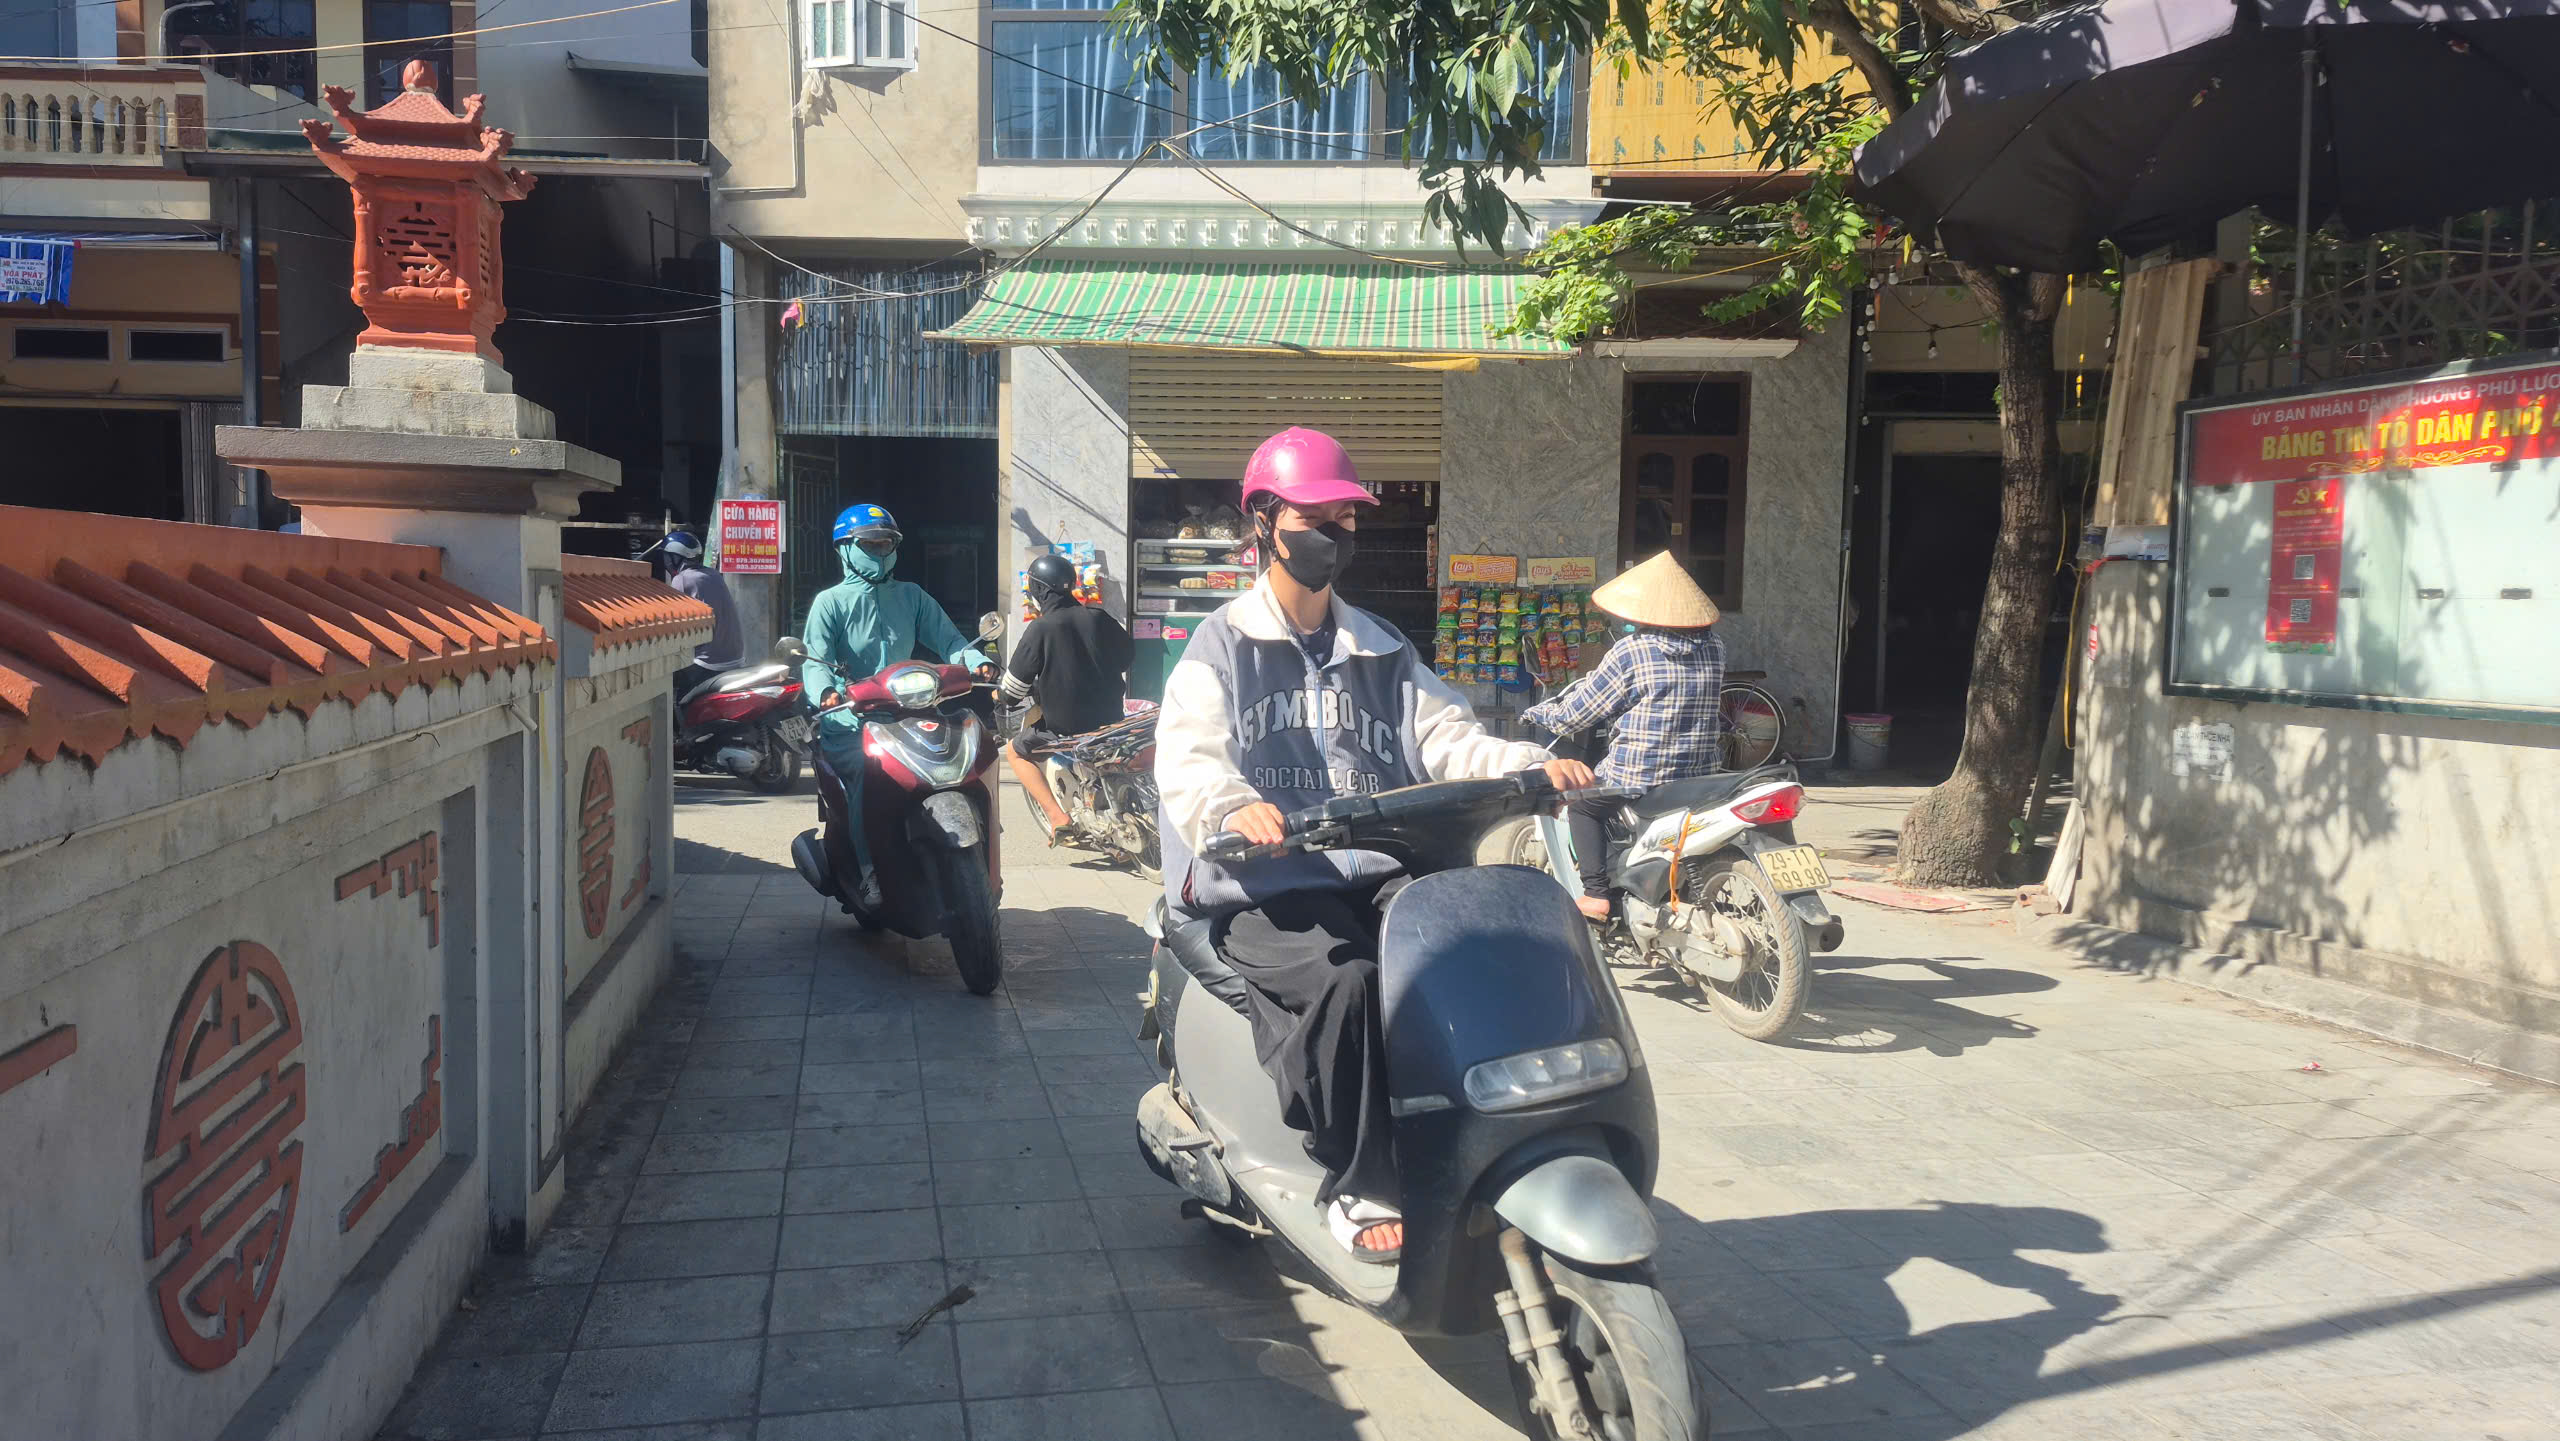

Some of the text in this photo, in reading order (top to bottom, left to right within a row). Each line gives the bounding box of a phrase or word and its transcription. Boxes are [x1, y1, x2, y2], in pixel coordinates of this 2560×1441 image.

[2275, 407, 2306, 423] BAN
[2310, 399, 2353, 419] NHÂN
[2358, 394, 2392, 413] DÂN
[2477, 375, 2517, 398] PHÚ
[2262, 425, 2326, 461] BẢNG
[2333, 424, 2372, 454] TIN
[2377, 408, 2411, 449] TỔ
[2416, 410, 2474, 446] DÂN
[2480, 394, 2546, 440] PHỐ
[724, 503, 777, 521] CỬA HÀNG
[1241, 688, 1394, 765] SYMBOIC
[1767, 848, 1812, 870] 29-T1
